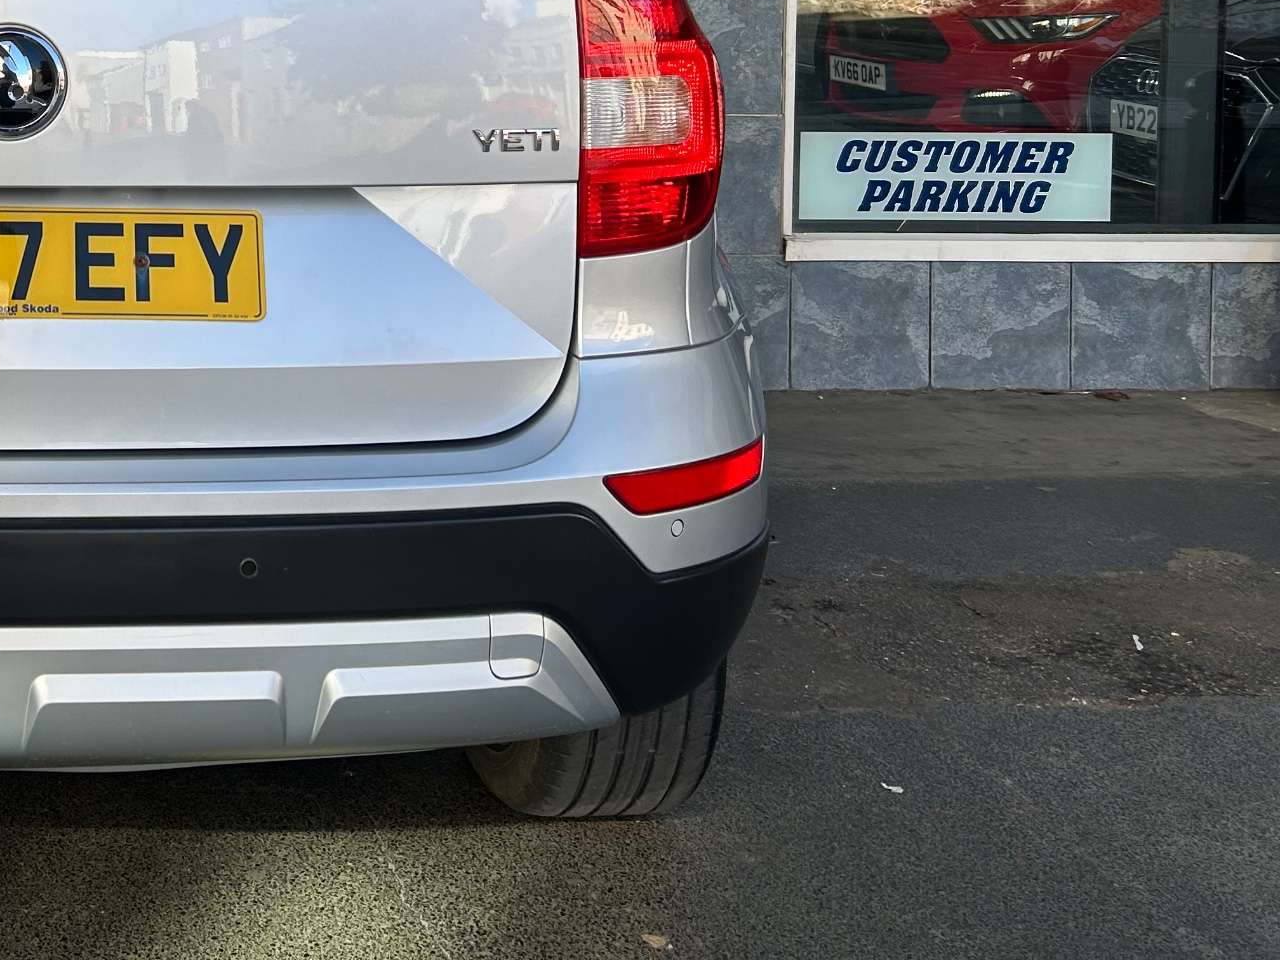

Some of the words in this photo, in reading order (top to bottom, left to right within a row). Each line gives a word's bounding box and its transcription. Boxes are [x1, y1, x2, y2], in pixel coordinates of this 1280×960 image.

[833, 59, 859, 81] KV66
[1117, 103, 1157, 134] YB22
[472, 128, 560, 152] YETI
[836, 139, 1075, 174] CUSTOMER
[857, 180, 1052, 214] PARKING
[75, 222, 244, 303] EFY
[22, 303, 59, 313] Skoda
